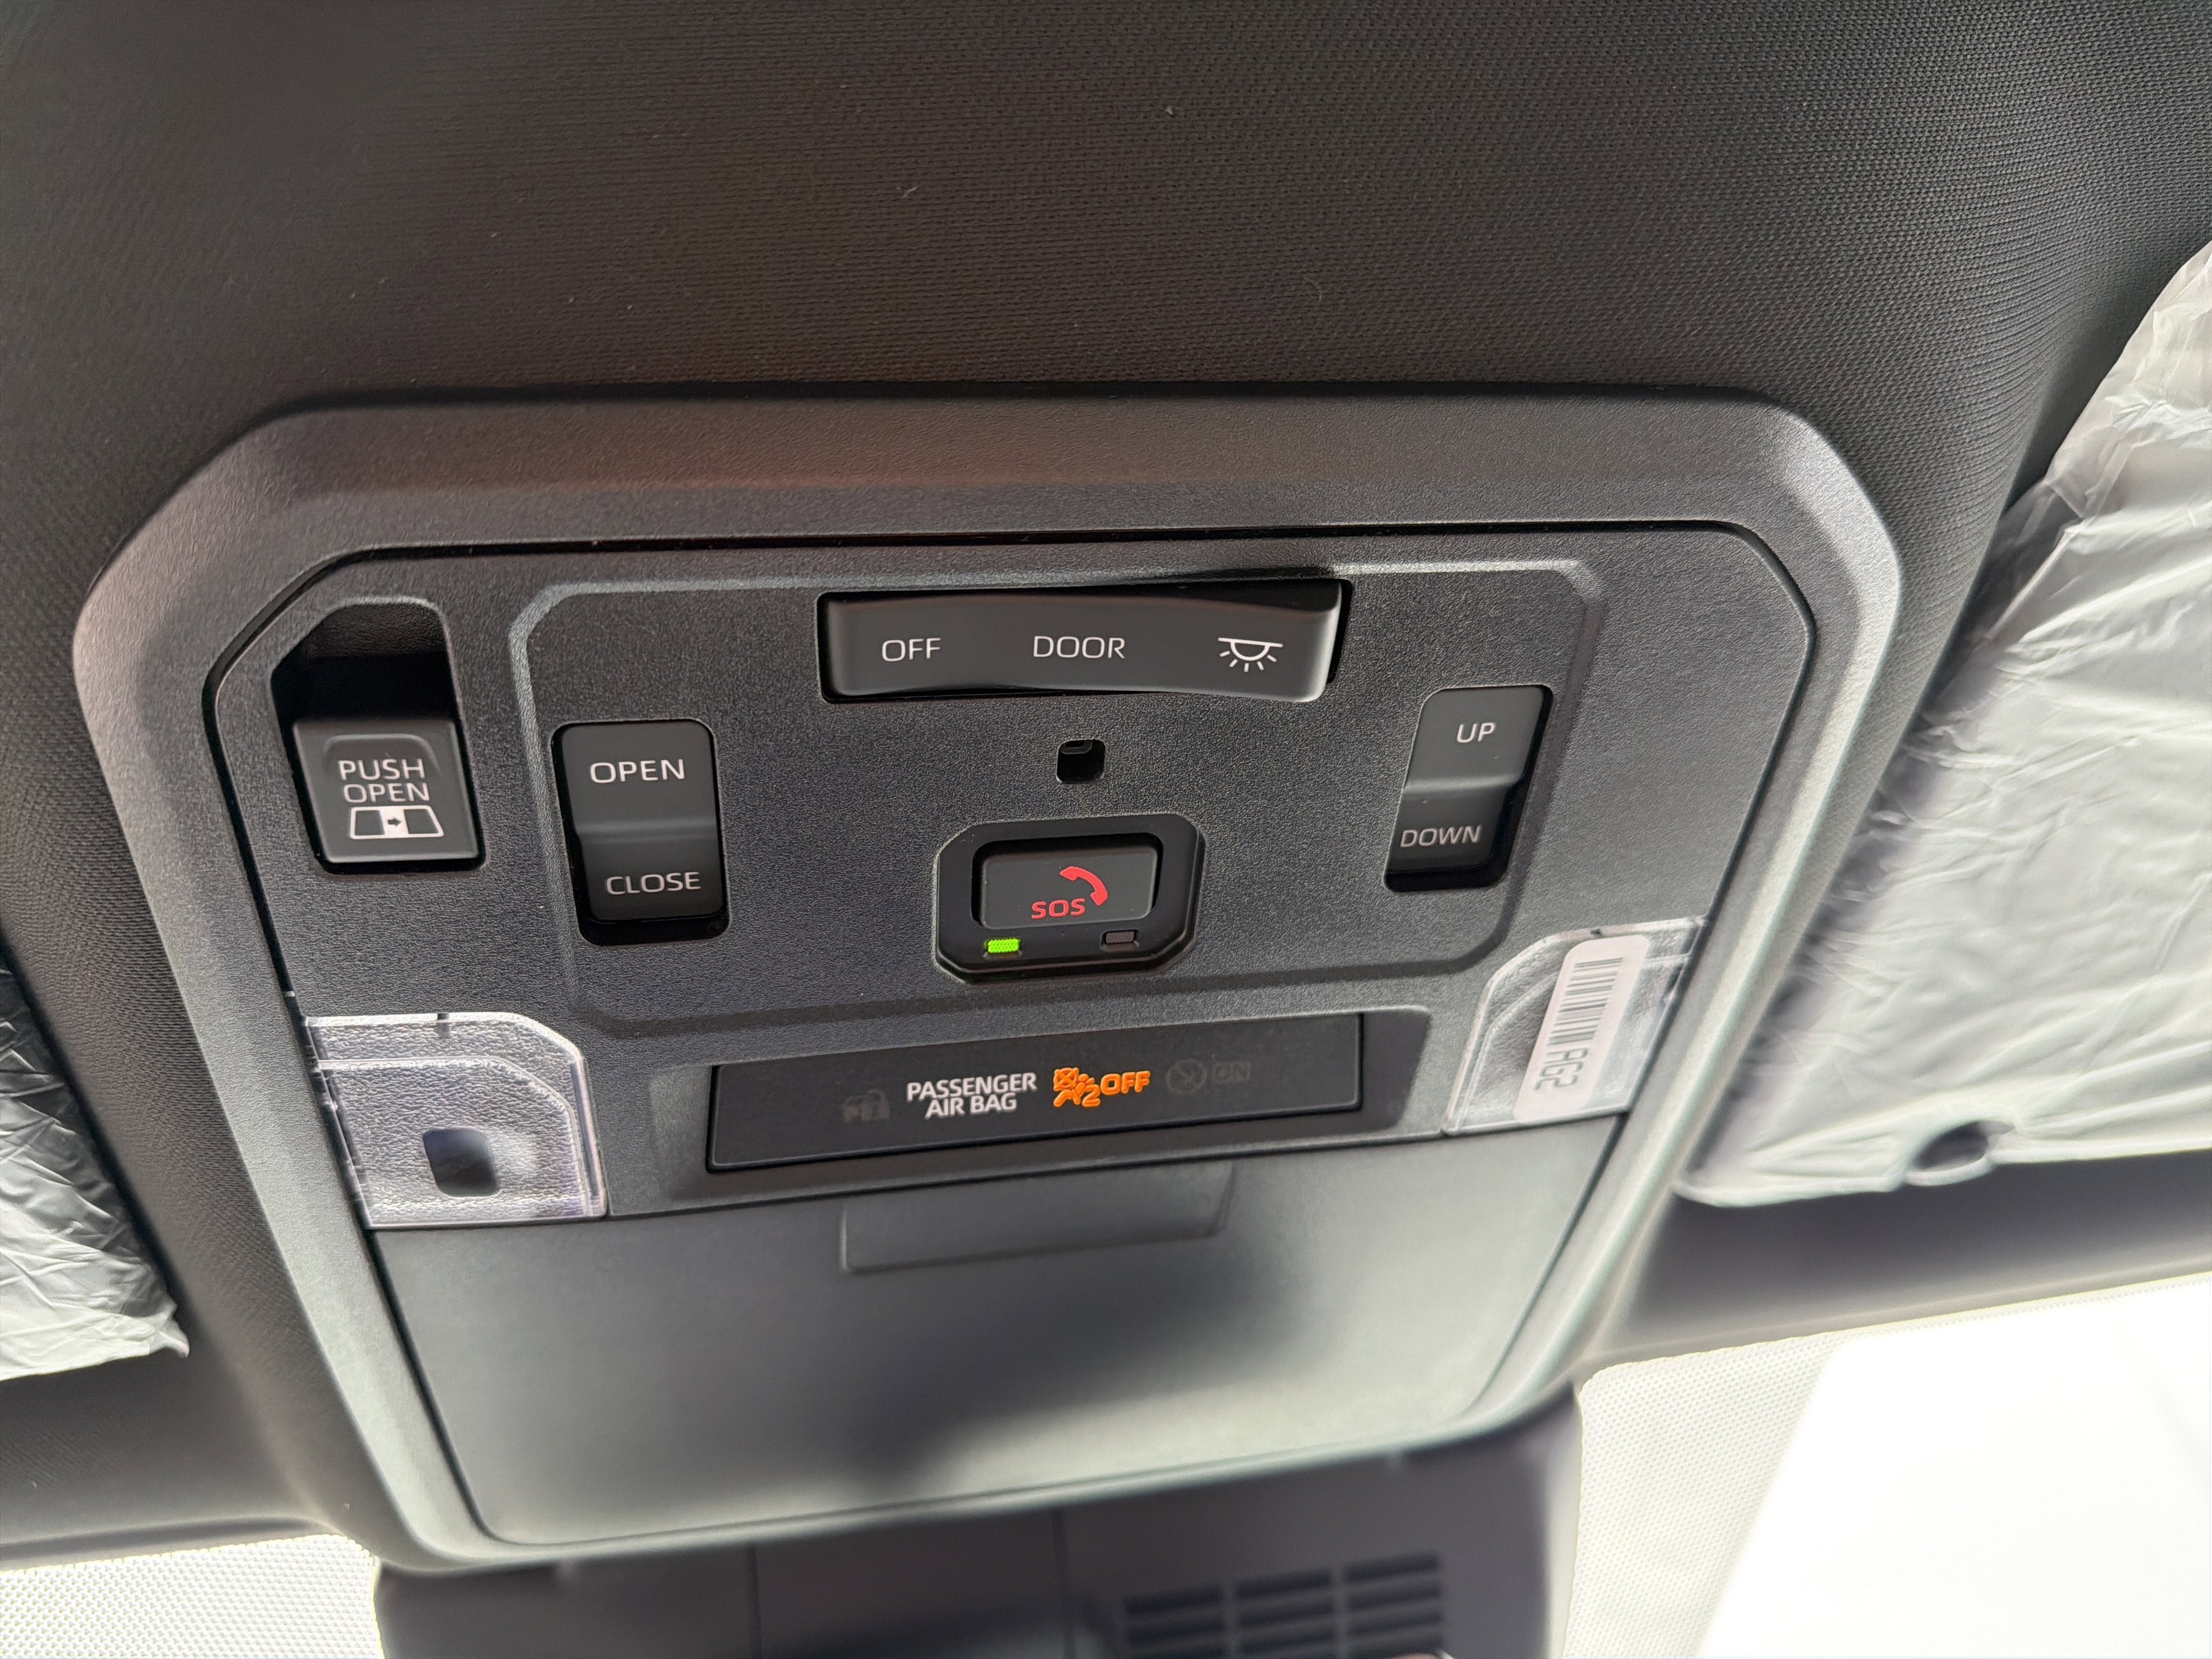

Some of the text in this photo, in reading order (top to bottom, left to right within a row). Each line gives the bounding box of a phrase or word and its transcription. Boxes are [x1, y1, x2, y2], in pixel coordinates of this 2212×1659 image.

[881, 637, 941, 662] OFF
[1032, 635, 1126, 659] DOOR
[1455, 721, 1497, 744] UP
[338, 758, 426, 781] PUSH
[589, 758, 686, 784] OPEN
[343, 782, 430, 803] OPEN
[1400, 824, 1482, 848] DOWN
[606, 871, 702, 895] CLOSE
[1031, 898, 1086, 920] SOS
[906, 1072, 1037, 1102] PASSENGER
[1100, 1070, 1150, 1095] OFF
[924, 1092, 1017, 1121] AIR BAG
